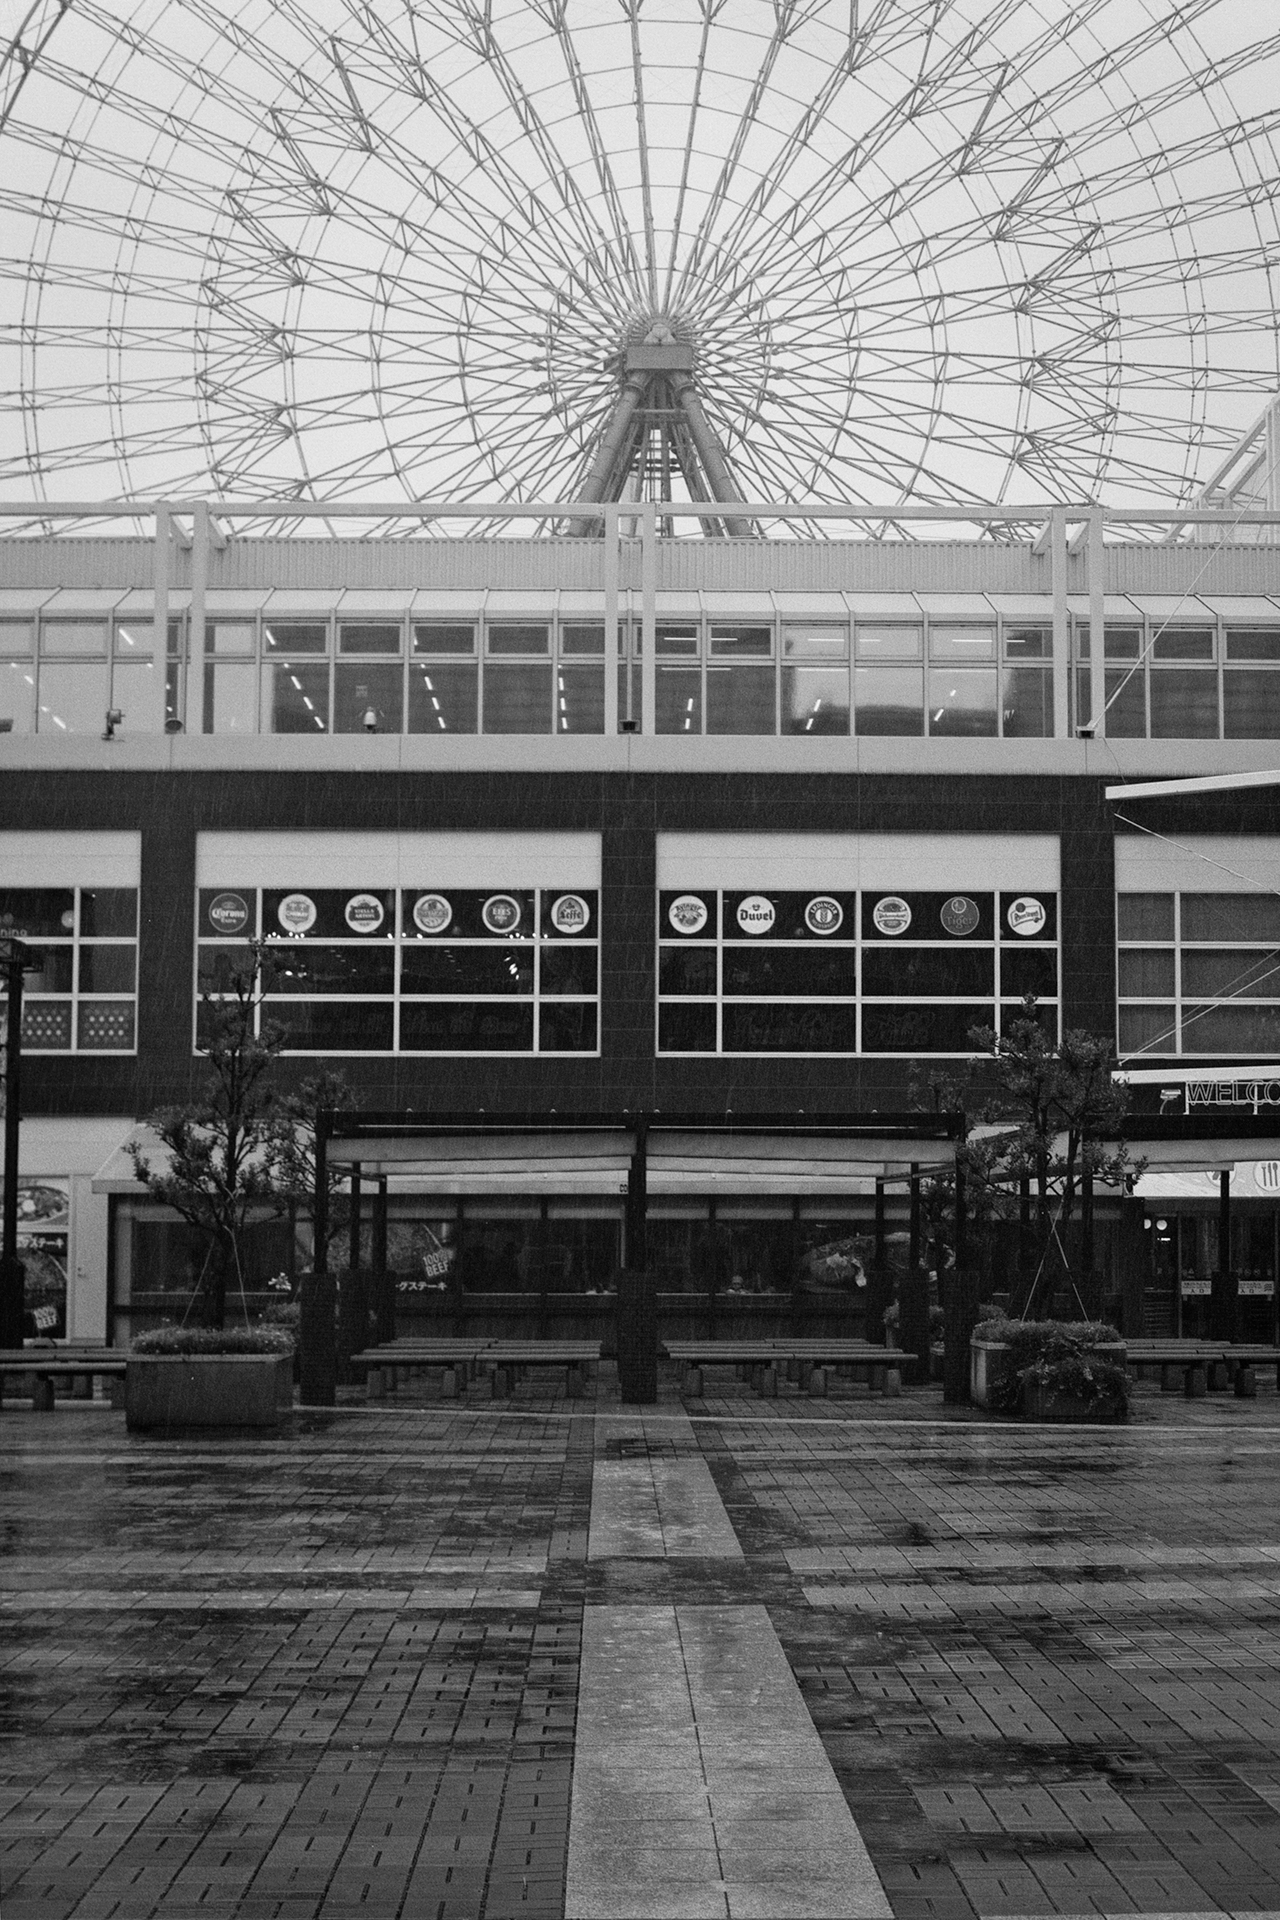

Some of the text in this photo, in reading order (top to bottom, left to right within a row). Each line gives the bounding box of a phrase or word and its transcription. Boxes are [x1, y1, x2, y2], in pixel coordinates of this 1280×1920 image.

[212, 908, 246, 918] Corona
[739, 908, 773, 921] Duvel
[945, 914, 973, 929] Tiger
[425, 1260, 449, 1277] BEEF
